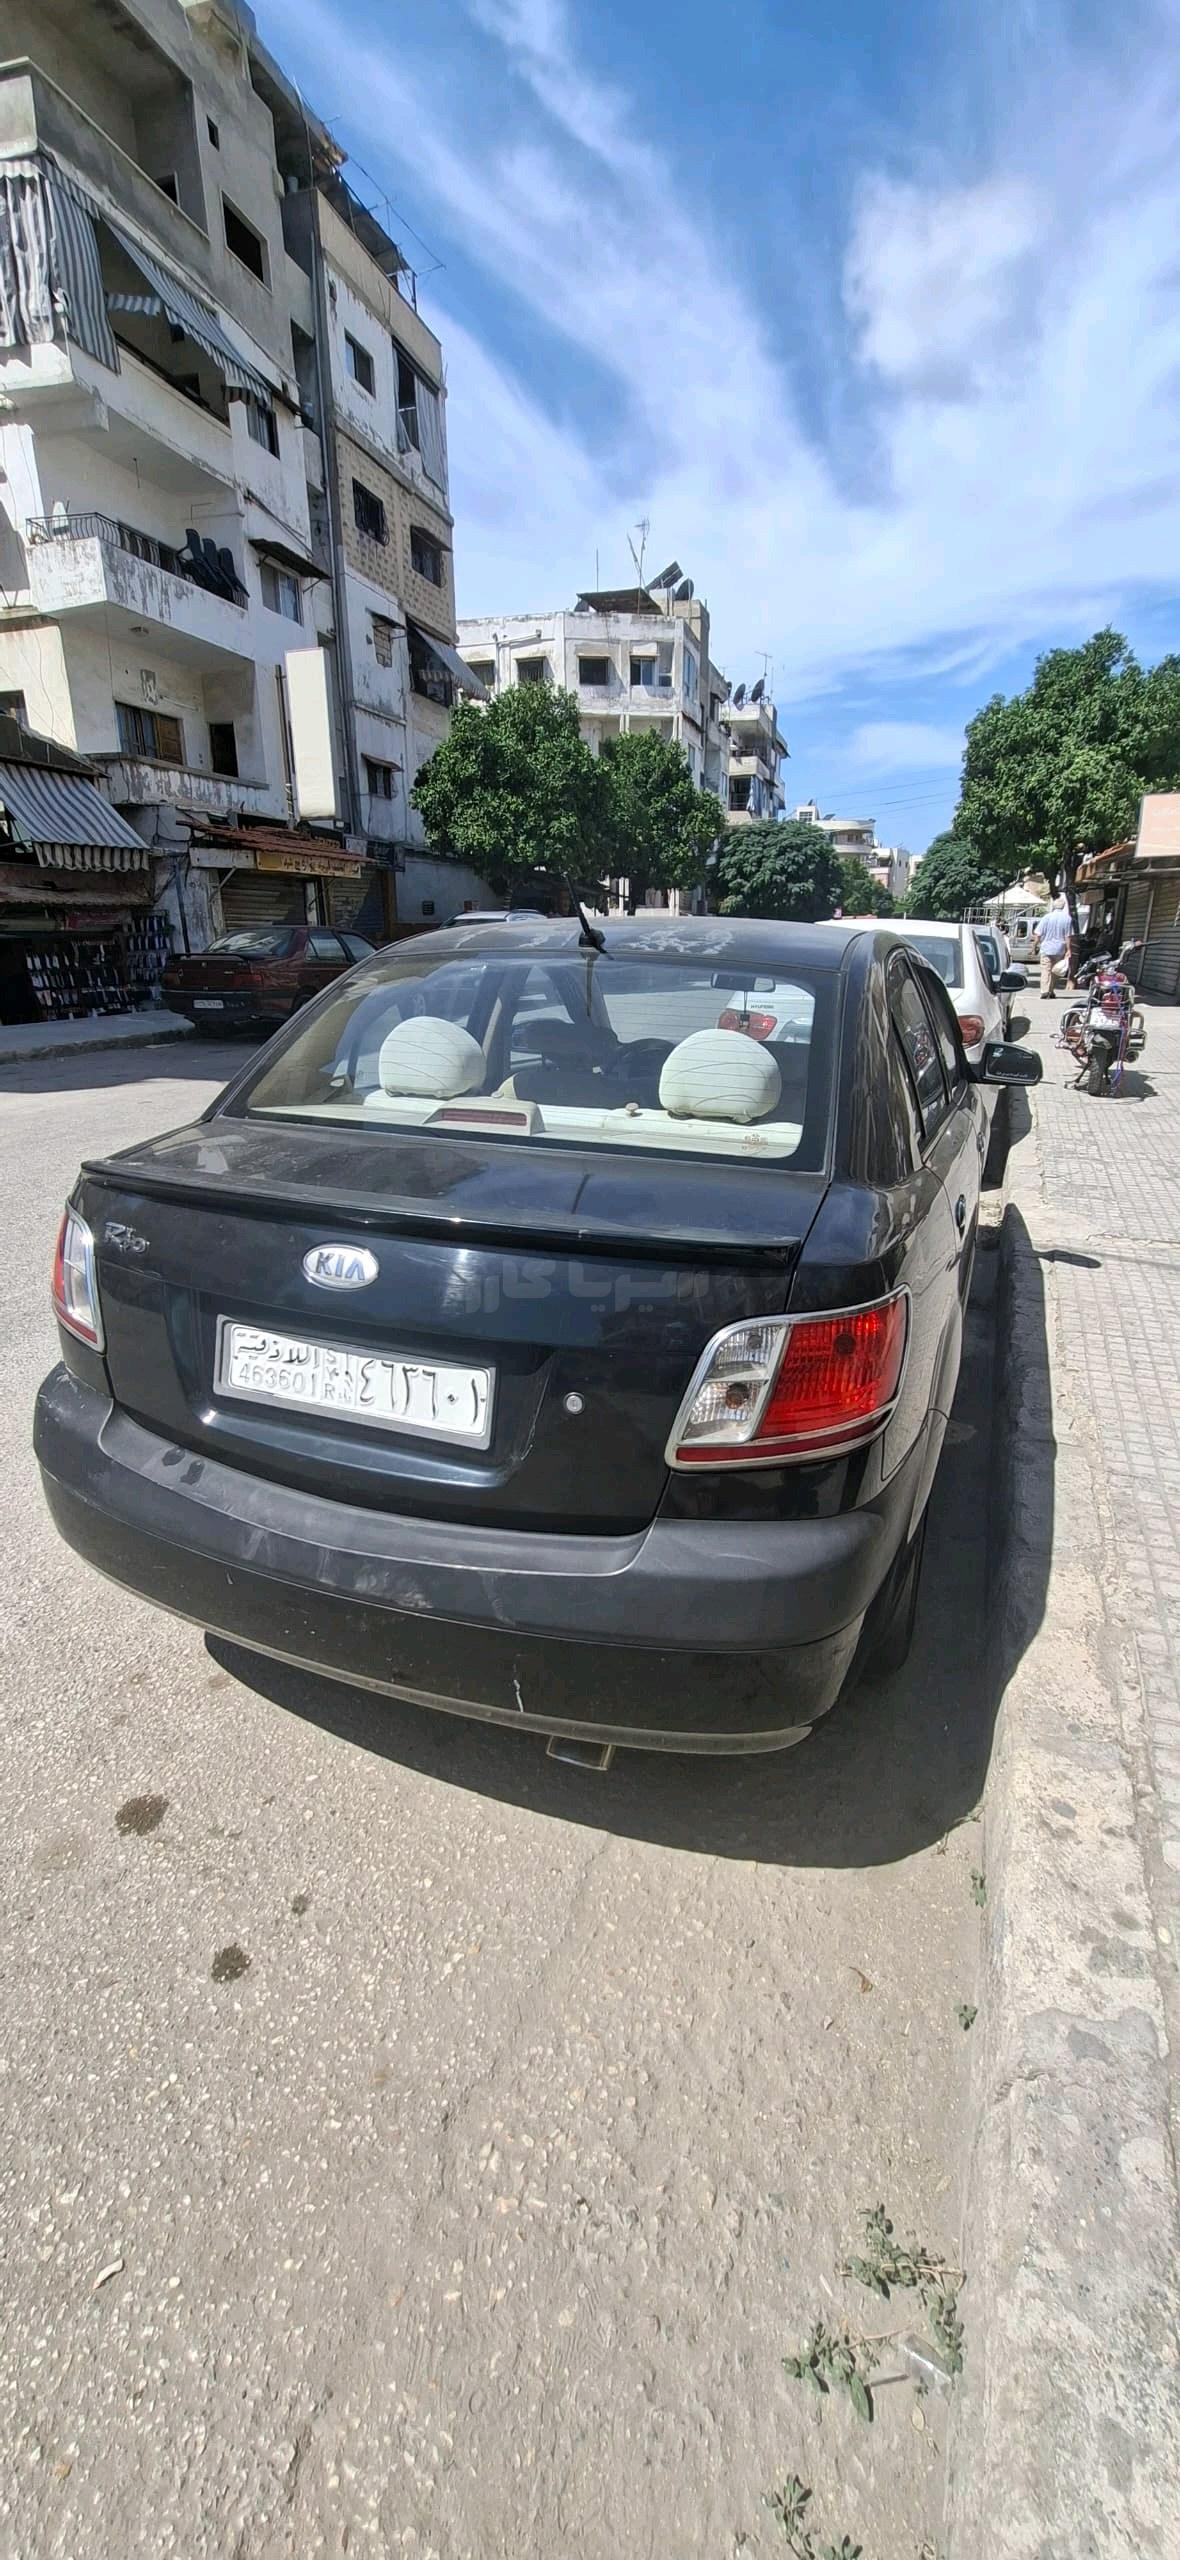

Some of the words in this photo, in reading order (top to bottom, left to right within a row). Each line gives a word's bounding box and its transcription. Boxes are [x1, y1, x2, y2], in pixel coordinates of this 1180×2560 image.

[105, 1222, 146, 1253] Rio
[316, 1252, 365, 1280] KIA
[236, 1333, 320, 1369] اللاذقية
[239, 1363, 316, 1398] 463601
[360, 1360, 477, 1426] ٤٦٣٦٠١
